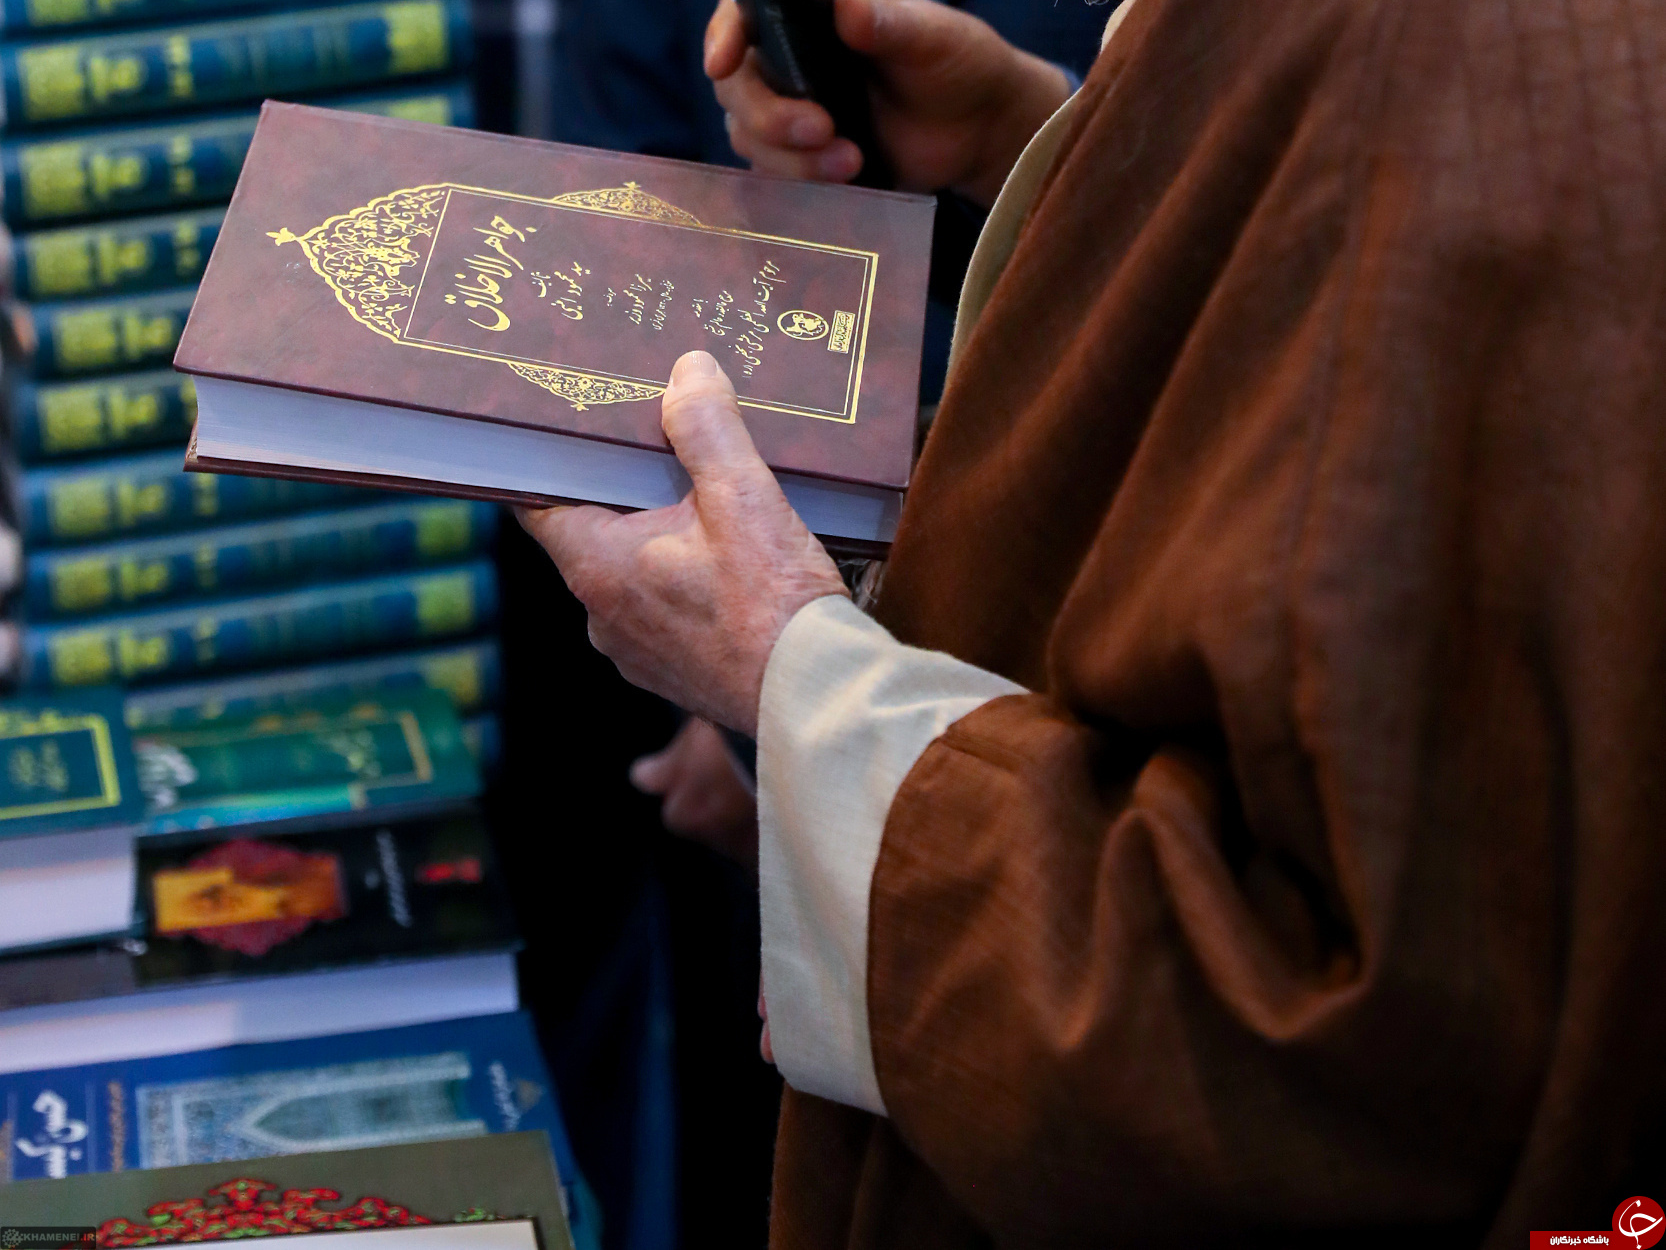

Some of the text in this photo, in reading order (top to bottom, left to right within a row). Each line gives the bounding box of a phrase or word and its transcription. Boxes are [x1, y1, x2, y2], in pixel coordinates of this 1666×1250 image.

[444, 215, 538, 332] جواهر الاخلاق
[570, 261, 592, 277] سید
[758, 260, 787, 284] مرحوم
[549, 270, 583, 297] محمود
[629, 273, 653, 292] میرزا
[622, 289, 645, 310] محمود
